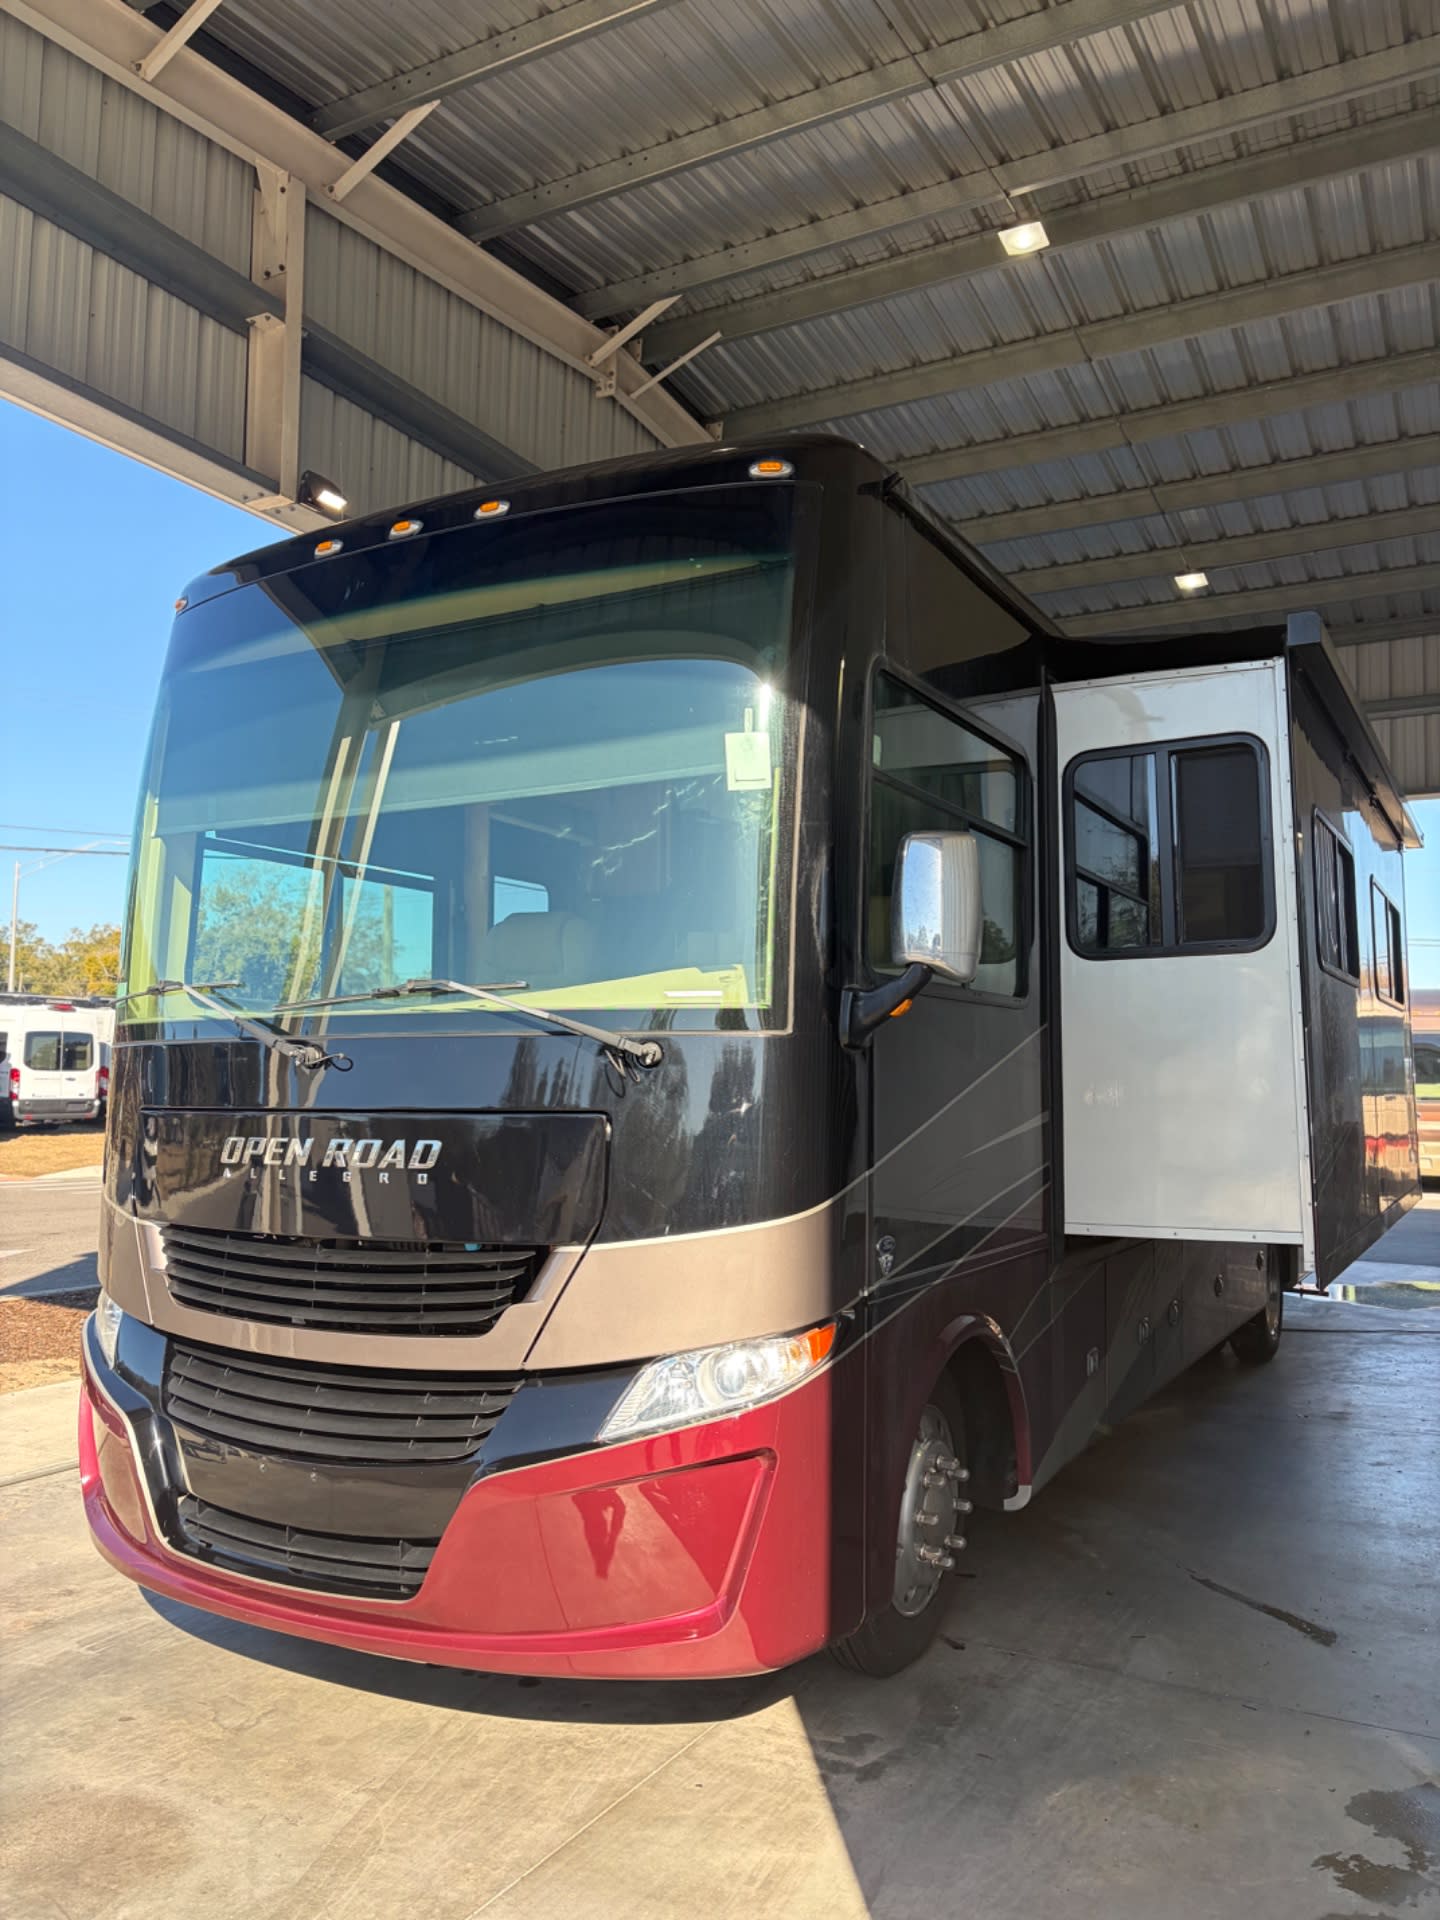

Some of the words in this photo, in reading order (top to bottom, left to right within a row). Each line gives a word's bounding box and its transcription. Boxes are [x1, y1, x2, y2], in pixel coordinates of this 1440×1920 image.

[220, 1136, 314, 1166] OPEN
[322, 1138, 443, 1170] ROAD
[222, 1167, 428, 1185] ALLEGRO
